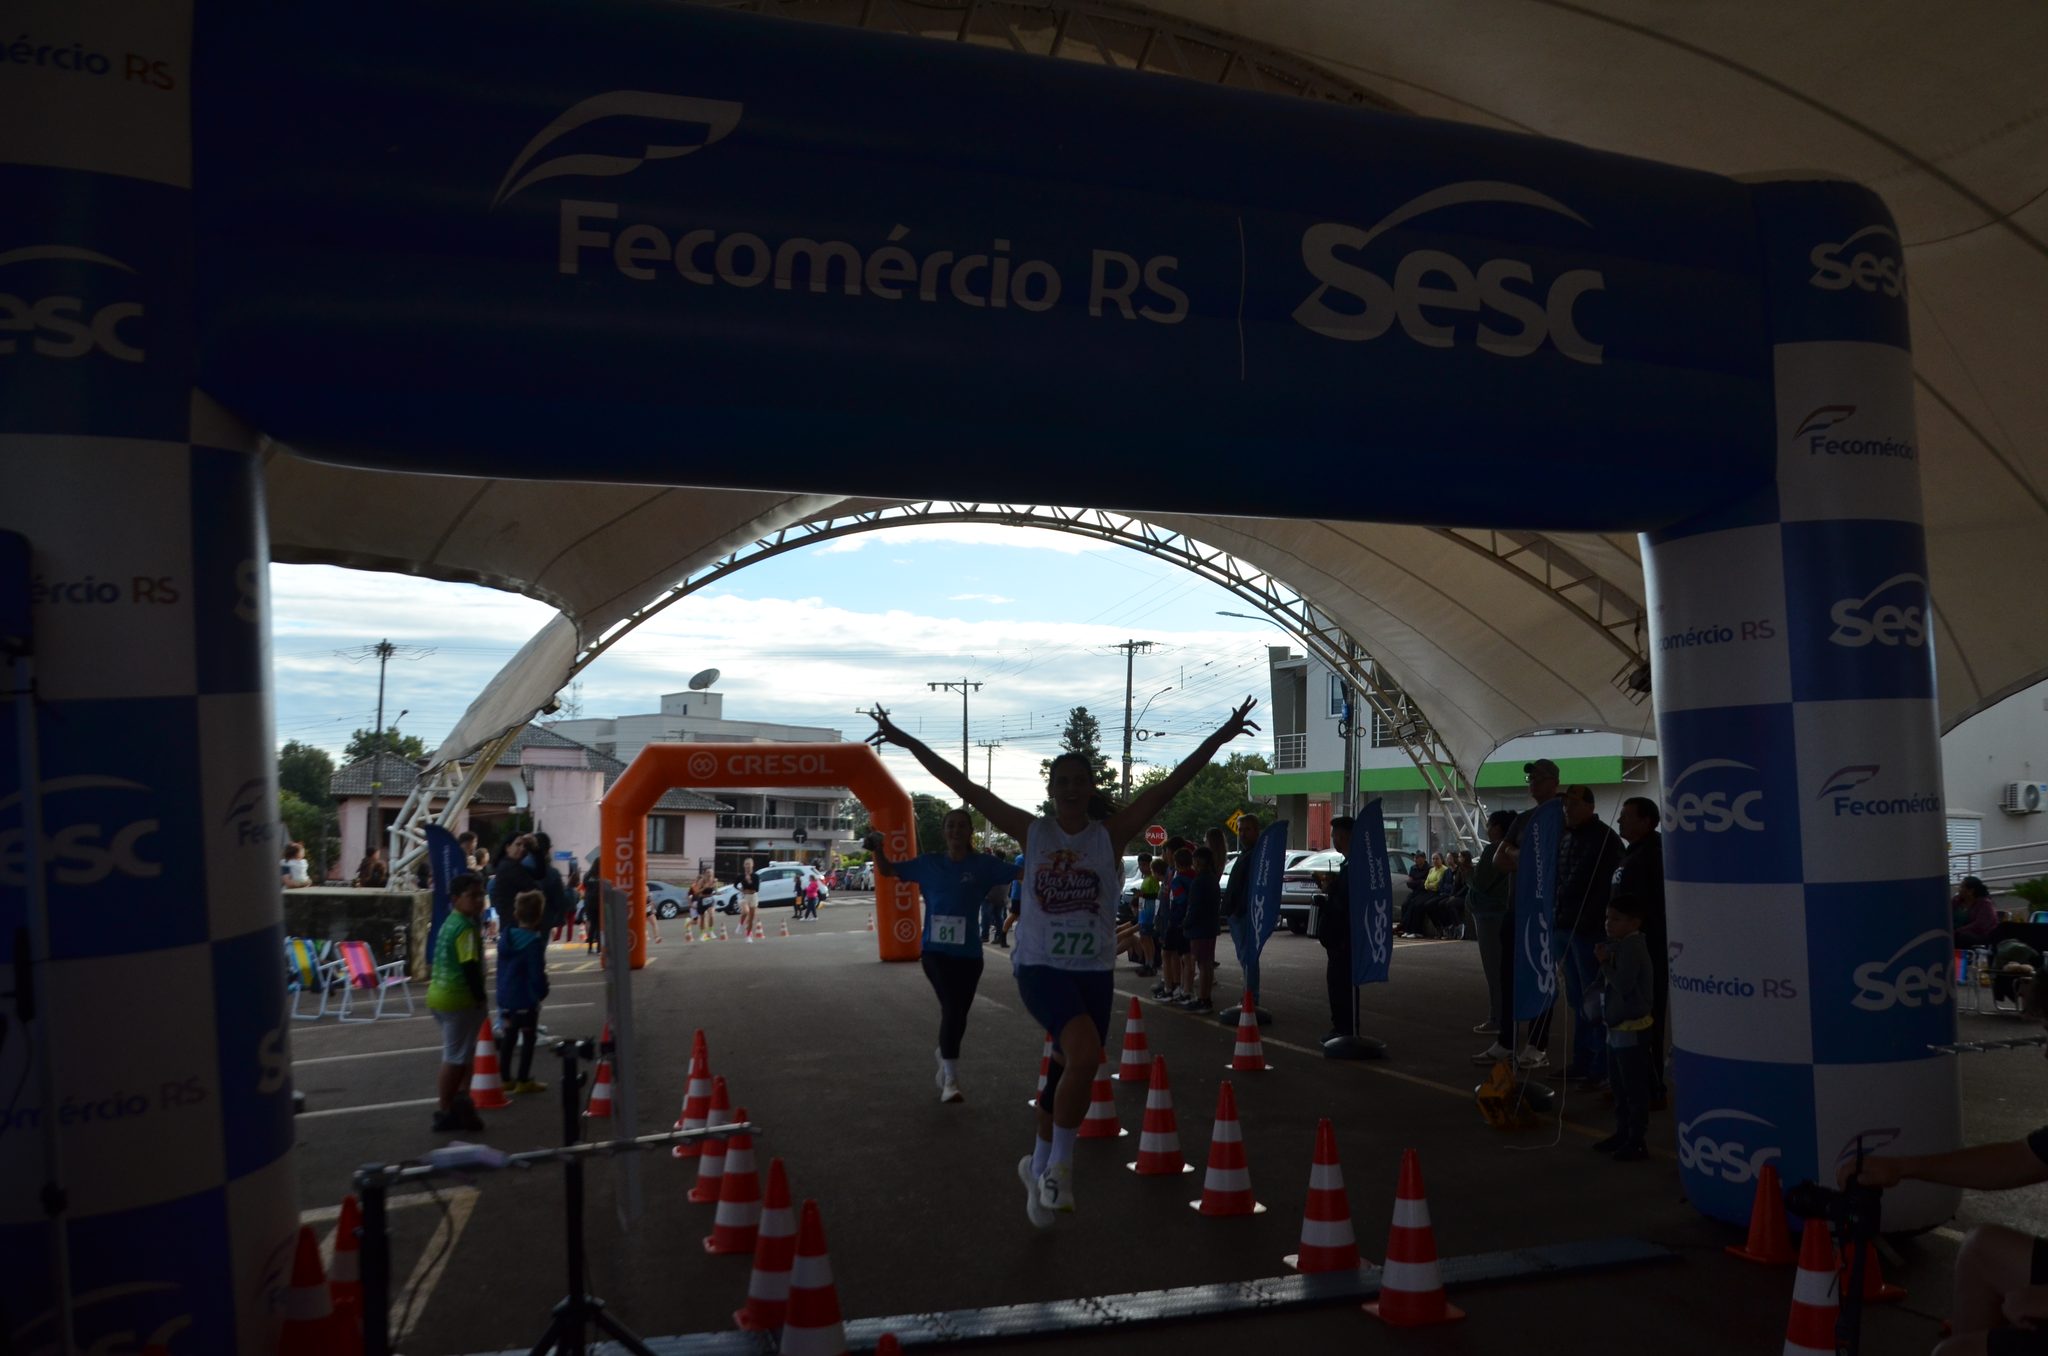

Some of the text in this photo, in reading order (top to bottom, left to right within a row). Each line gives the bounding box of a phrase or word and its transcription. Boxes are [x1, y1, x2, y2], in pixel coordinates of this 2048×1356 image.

[0, 34, 176, 90] ércio RS
[559, 199, 1191, 325] Fecomércio RS
[1809, 243, 1907, 298] Ses
[1291, 221, 1607, 365] Sesc
[132, 576, 180, 605] RS
[1741, 619, 1776, 641] RS
[1828, 598, 1927, 648] Ses
[727, 754, 834, 775] CRESOL
[1146, 831, 1165, 840] PARE
[615, 829, 635, 919] ESOL
[891, 822, 912, 912] CRSOL
[1043, 886, 1097, 904] Param
[939, 926, 955, 942] 81
[1051, 931, 1096, 955] 272
[1372, 898, 1388, 964] Sesc
[1669, 969, 1798, 999] ecomércio RS
[160, 1075, 208, 1111] RS
